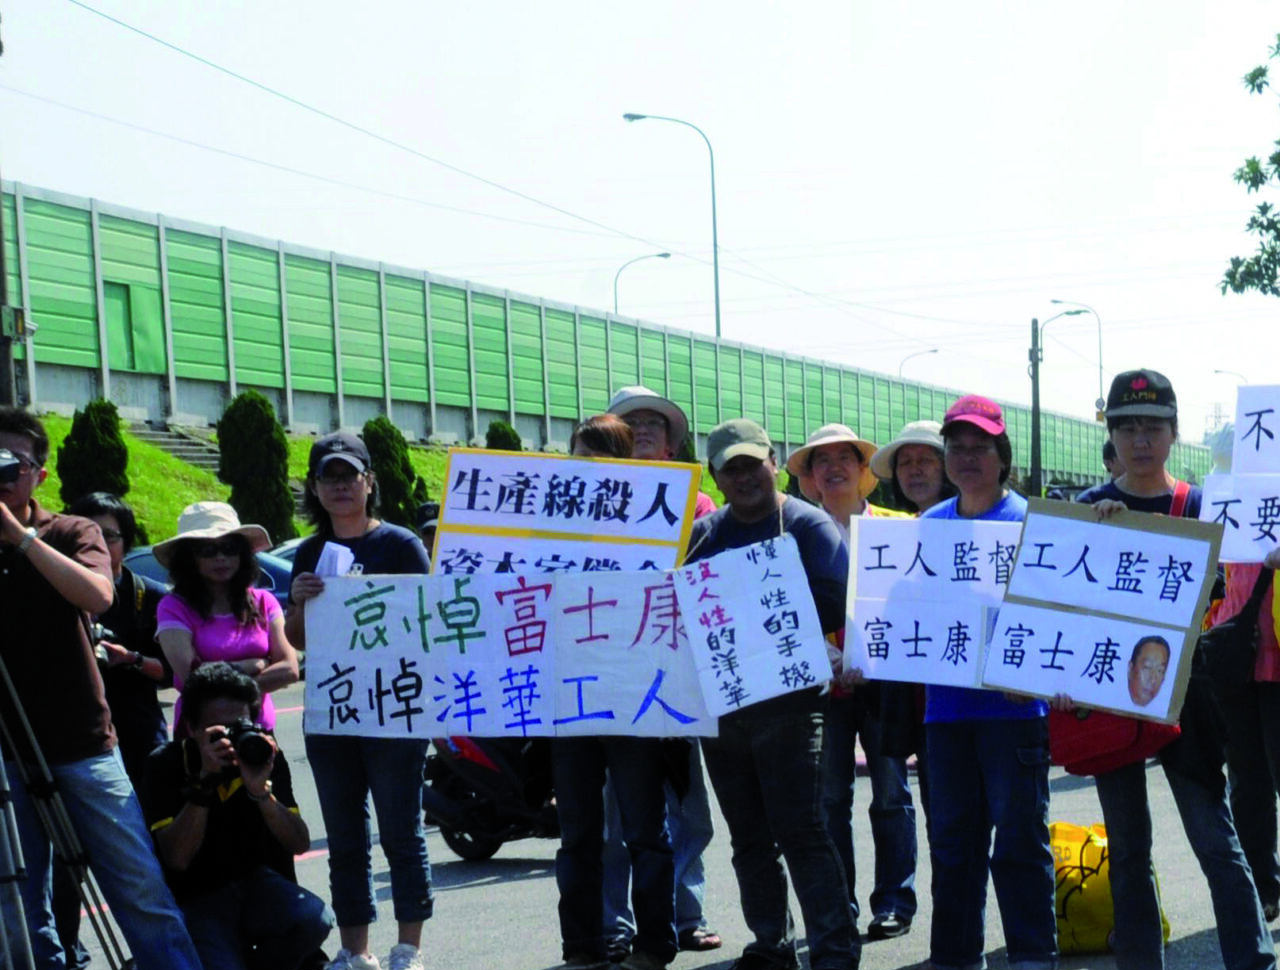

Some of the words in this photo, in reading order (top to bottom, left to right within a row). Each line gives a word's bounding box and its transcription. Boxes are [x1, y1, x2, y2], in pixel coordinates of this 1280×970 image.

[450, 468, 680, 527] 生產線殺人
[864, 540, 1021, 585] 工人監督
[1023, 543, 1195, 603] 工人監督
[344, 576, 689, 657] 哀悼富士康
[864, 617, 972, 666] 富士康
[1002, 623, 1122, 684] 富士康
[317, 657, 699, 736] 哀悼洋華工人
